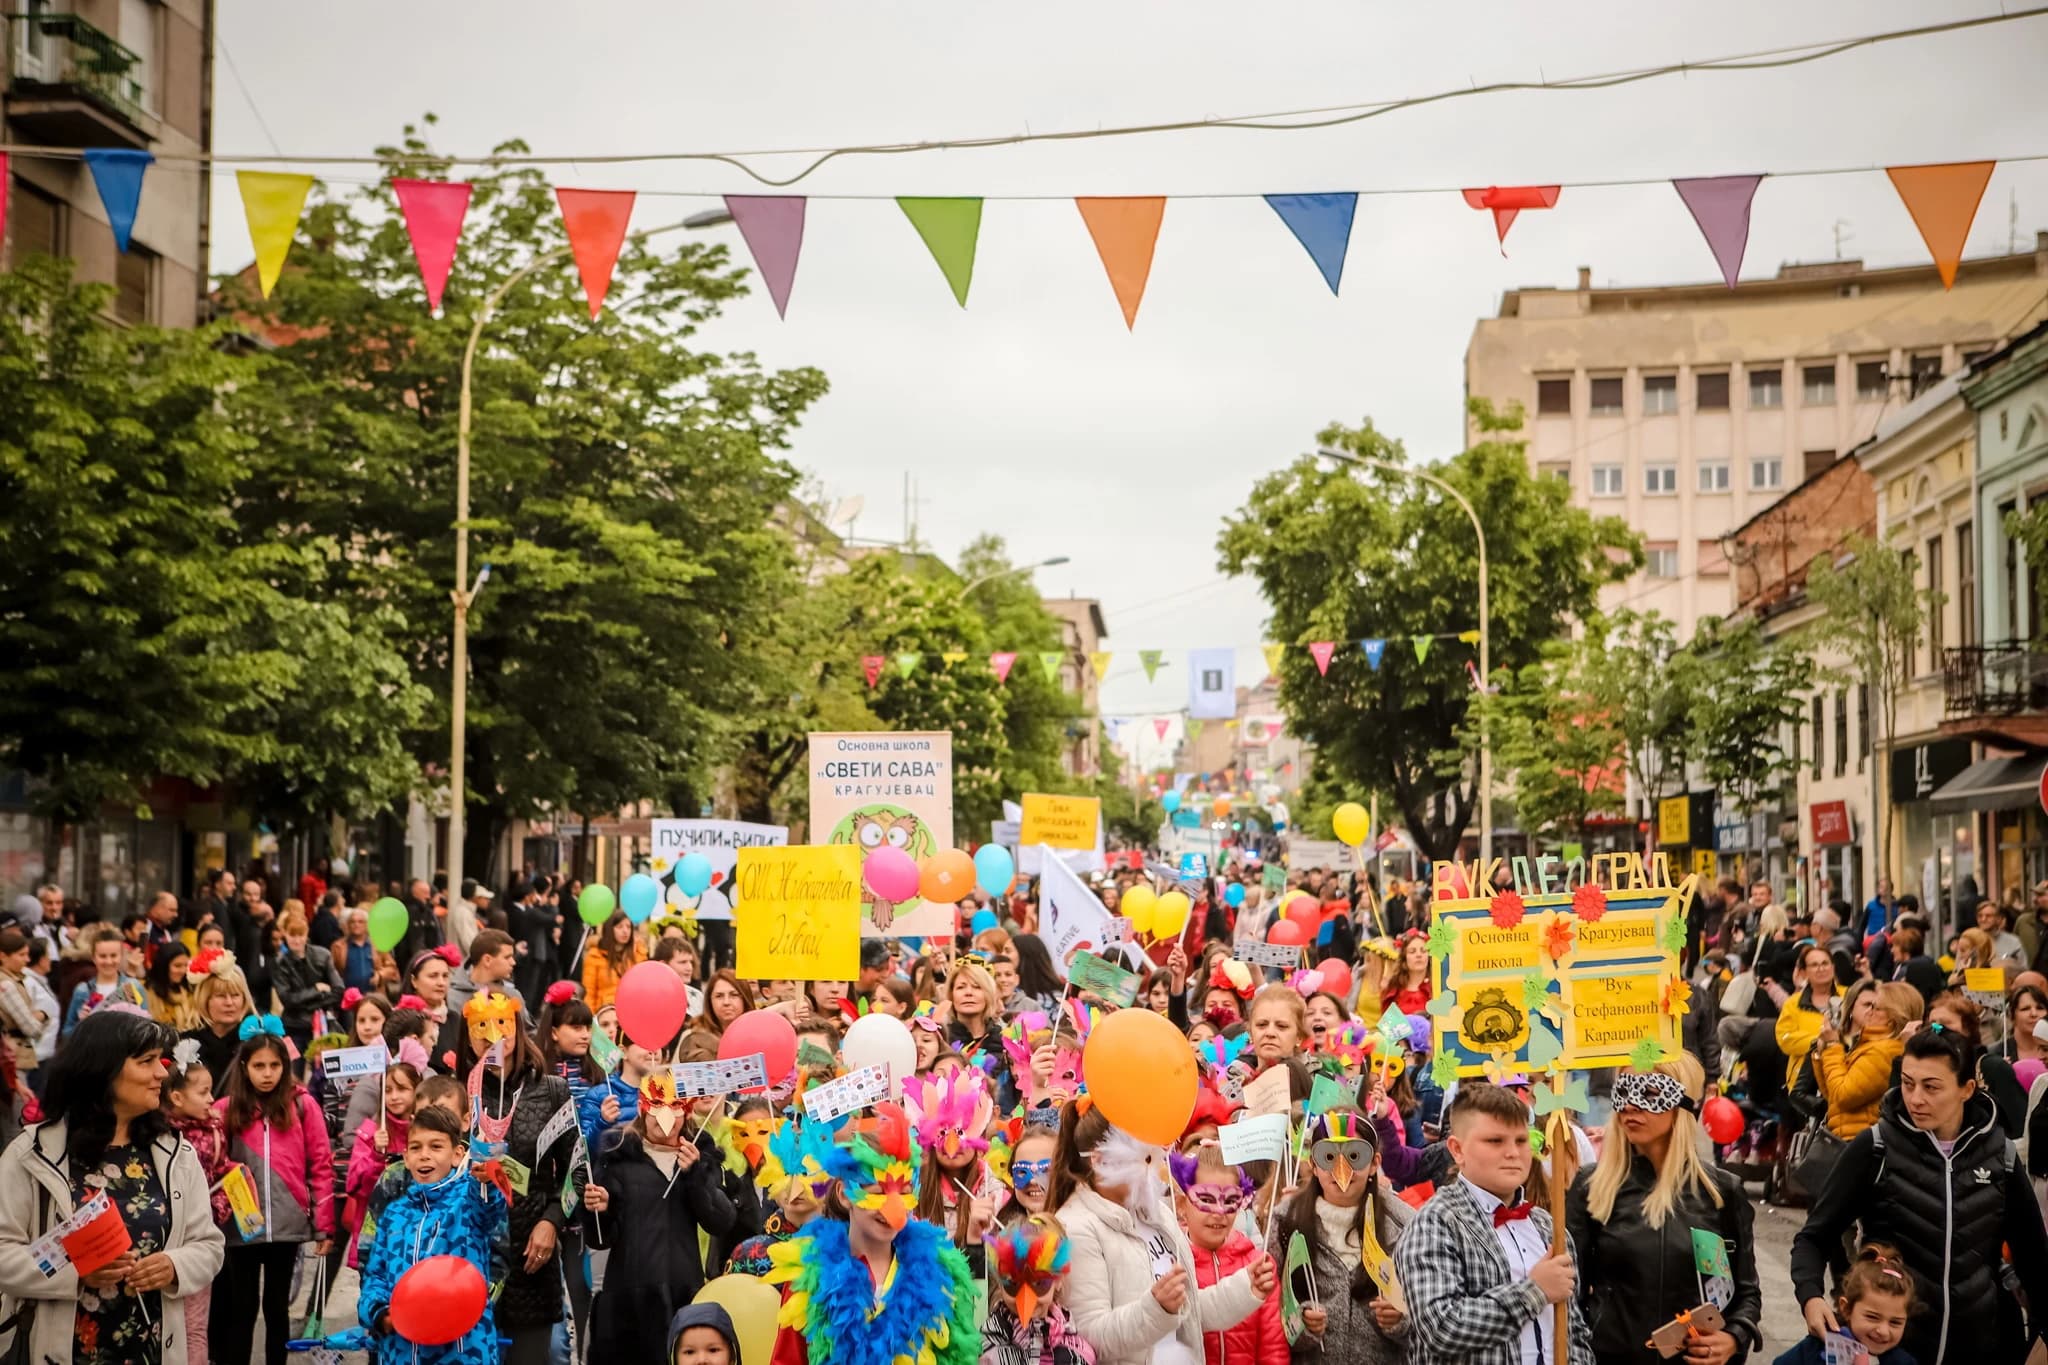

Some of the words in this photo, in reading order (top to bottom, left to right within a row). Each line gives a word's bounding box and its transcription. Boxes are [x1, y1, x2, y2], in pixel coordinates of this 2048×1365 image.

[838, 739, 889, 751] Основна
[893, 740, 930, 751] школа
[835, 783, 934, 796] КРАГУЈЕВАЦ
[1432, 857, 1503, 900] ВУК
[1468, 930, 1530, 946] Основна
[1578, 922, 1656, 945] Крагујевац
[1477, 957, 1523, 970] школа
[1573, 999, 1659, 1025] Стефановић
